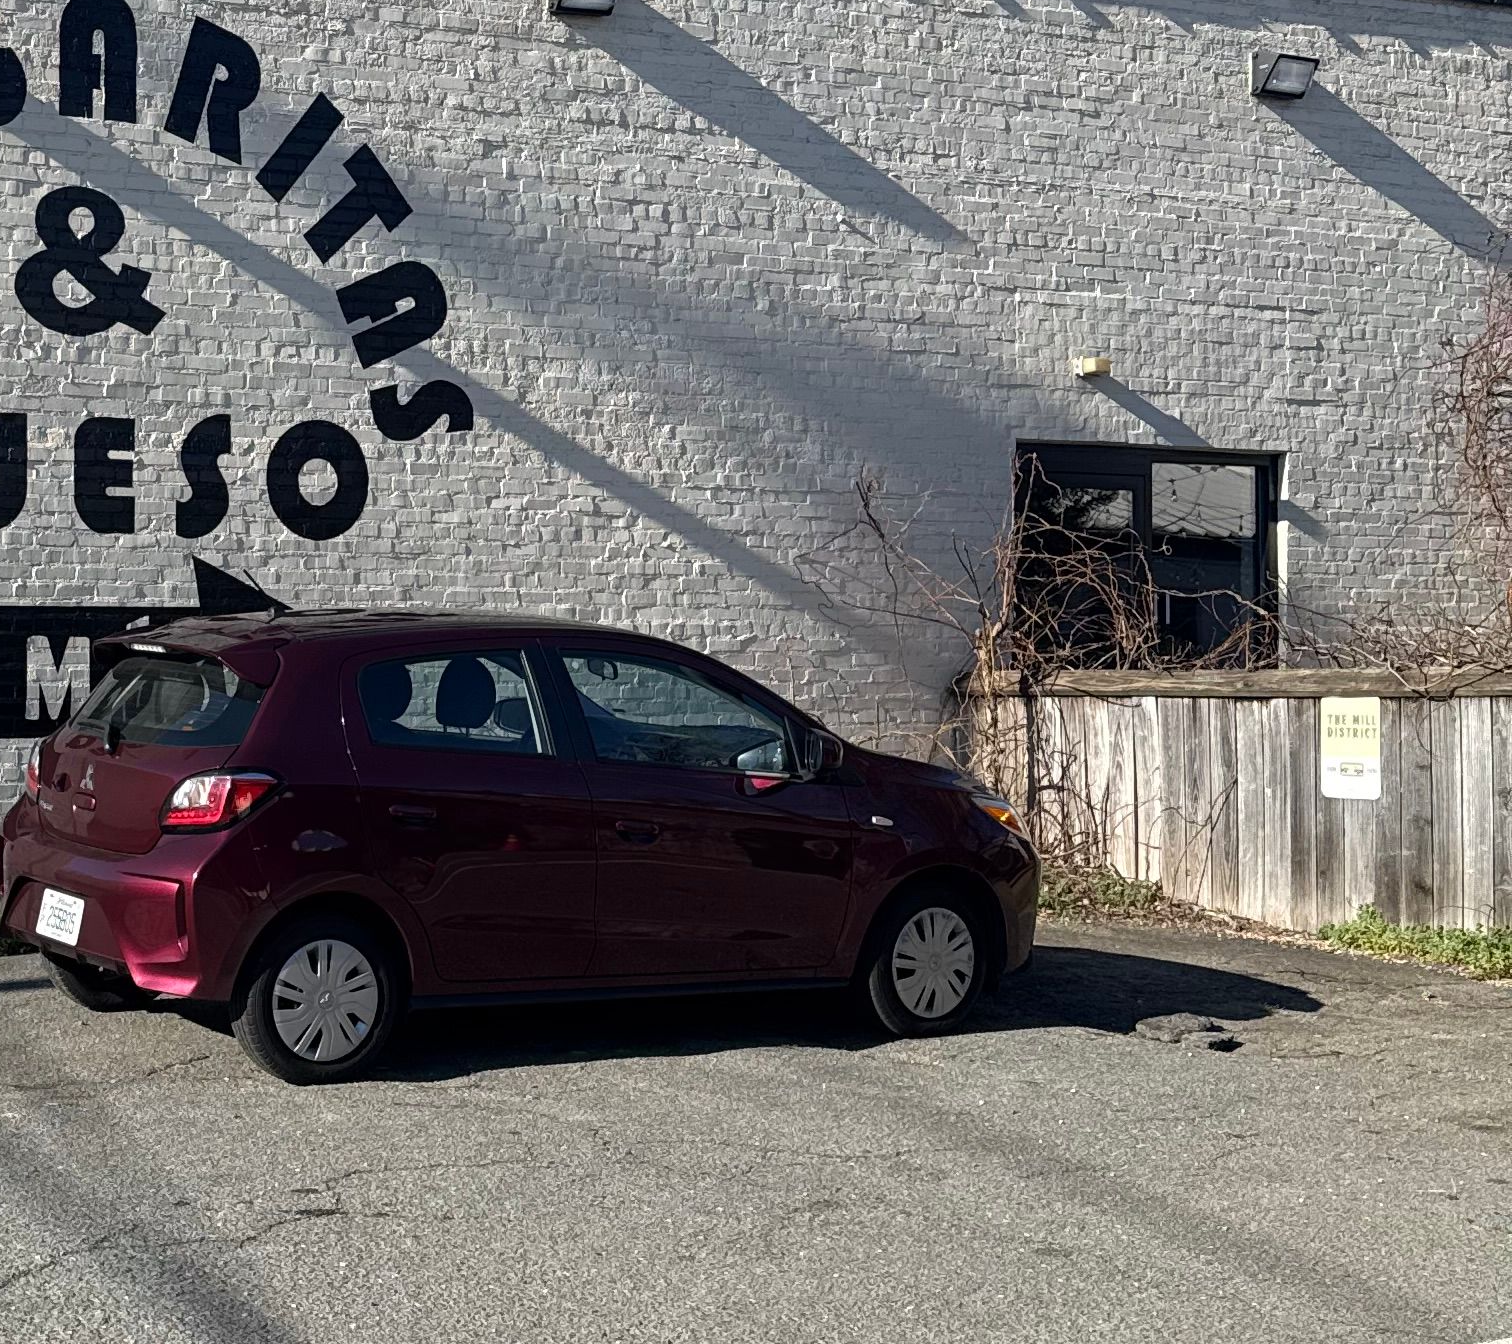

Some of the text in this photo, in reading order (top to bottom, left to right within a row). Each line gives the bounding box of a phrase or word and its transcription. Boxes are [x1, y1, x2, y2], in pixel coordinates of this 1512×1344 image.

[14, 186, 166, 337] &
[1327, 714, 1377, 726] THE MILL
[1327, 726, 1378, 739] DISTRICT
